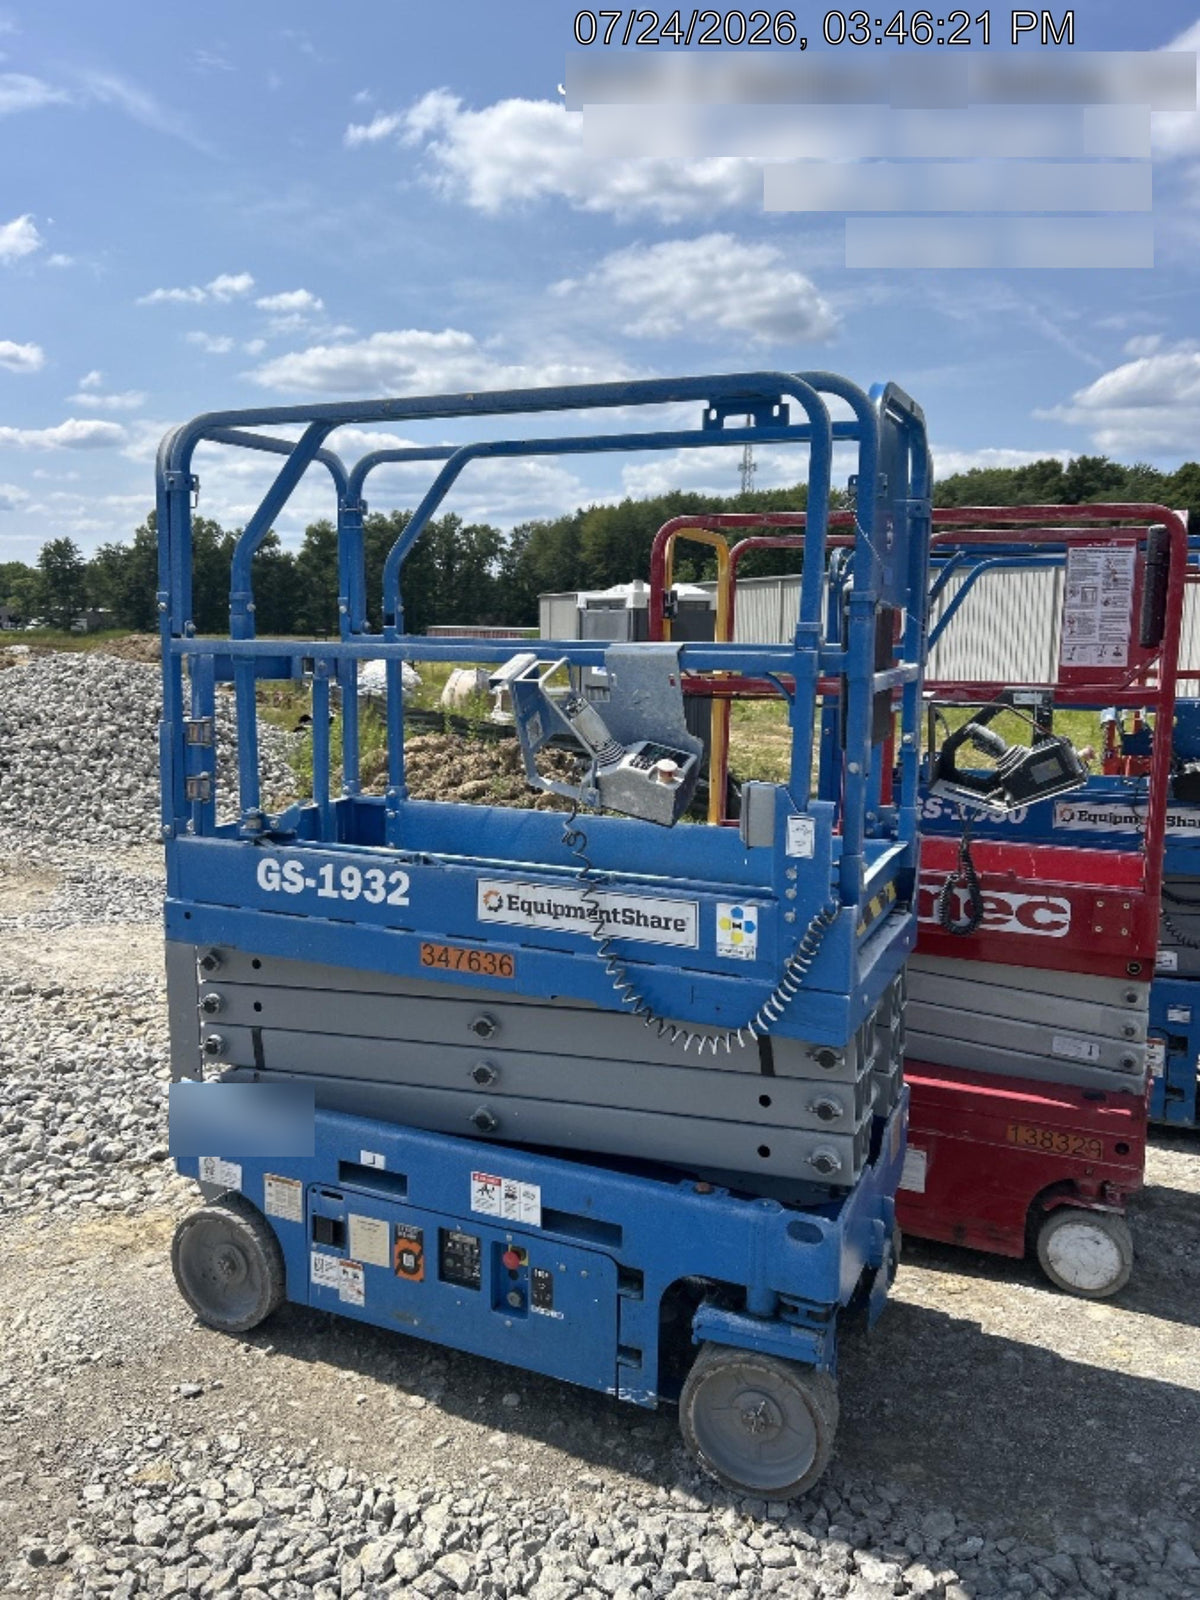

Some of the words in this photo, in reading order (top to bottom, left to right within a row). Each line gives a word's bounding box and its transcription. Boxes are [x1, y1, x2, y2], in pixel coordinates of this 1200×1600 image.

[257, 858, 410, 906] GS-1932
[506, 894, 686, 932] EquipmentShare
[422, 943, 513, 977] 347636
[1011, 1126, 1101, 1158] 138329
